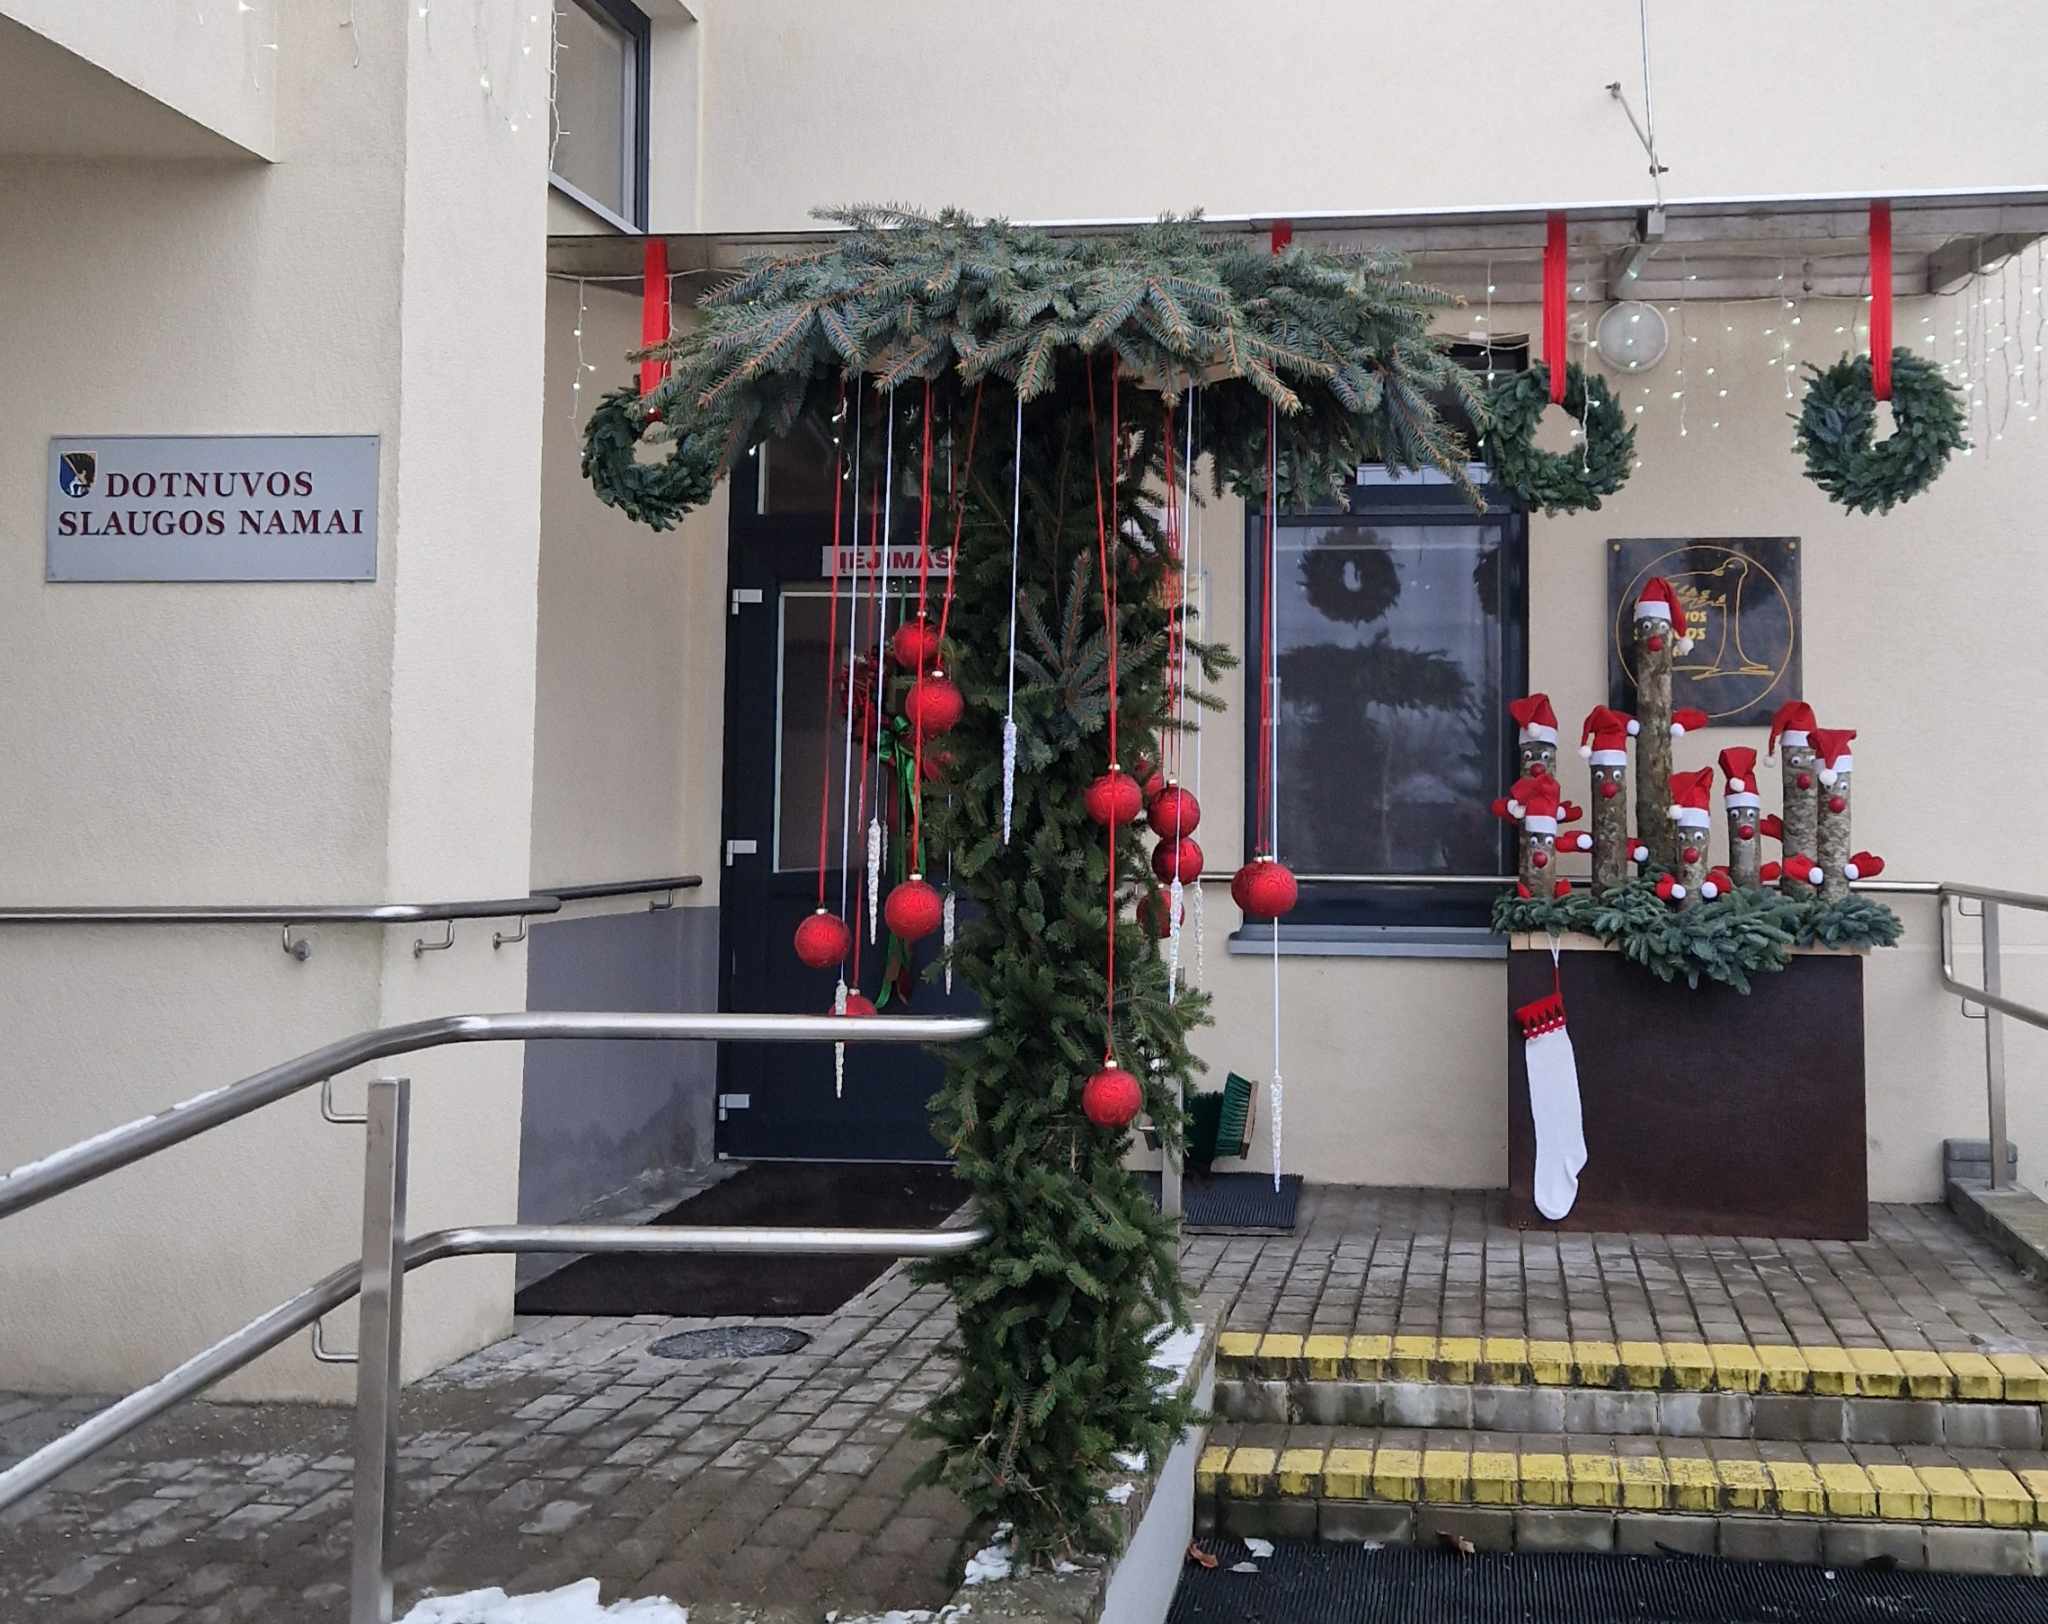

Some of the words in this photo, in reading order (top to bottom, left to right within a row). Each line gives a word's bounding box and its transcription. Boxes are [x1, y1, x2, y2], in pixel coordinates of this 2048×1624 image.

[105, 471, 313, 497] DOTNUVOS
[58, 510, 226, 536] SLAUGOS
[238, 509, 364, 534] NAMAI
